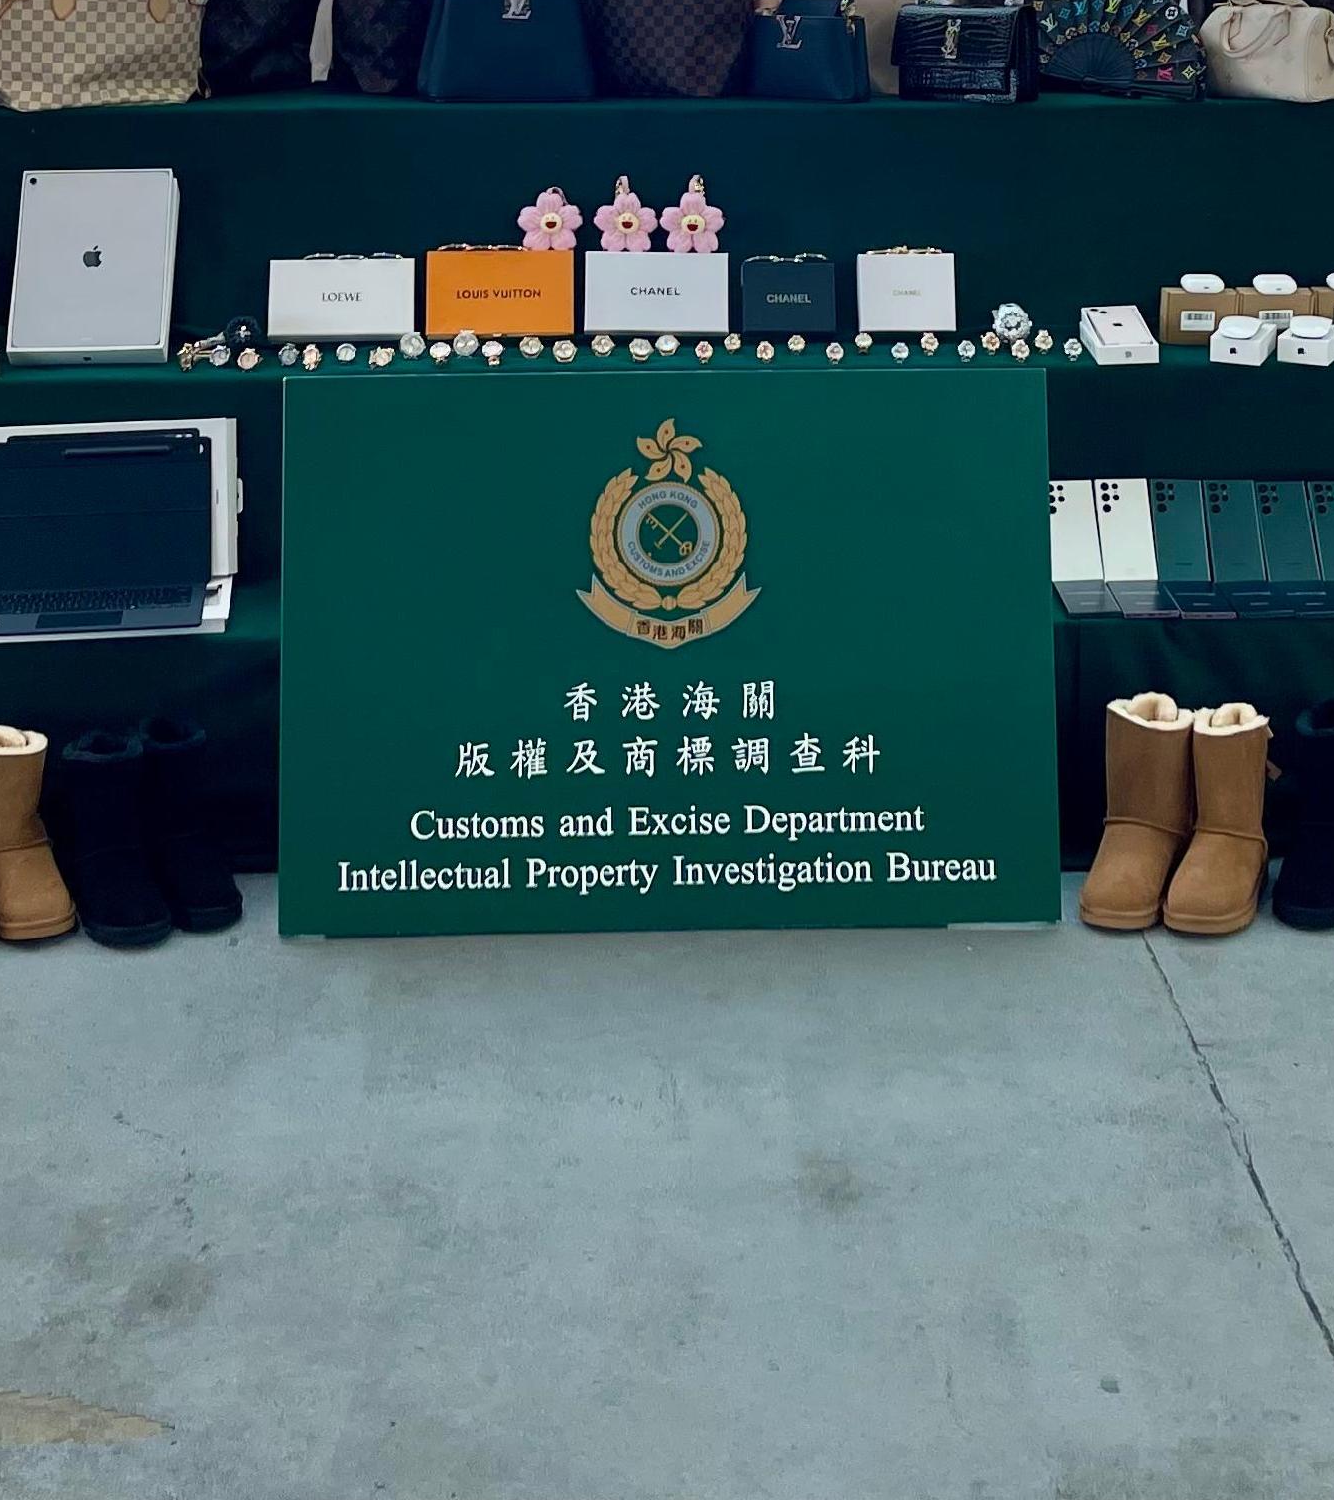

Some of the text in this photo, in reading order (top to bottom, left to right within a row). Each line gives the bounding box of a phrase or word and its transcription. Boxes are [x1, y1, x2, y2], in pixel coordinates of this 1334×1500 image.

[321, 291, 363, 303] LOEWE
[456, 287, 542, 300] LOUIS VUITTON
[629, 286, 682, 297] CHANEL
[766, 293, 812, 304] CHANEL
[638, 490, 699, 510] HONG KONG
[627, 541, 711, 578] CUSTOMS AND EXCISE
[563, 680, 776, 722] 香港海關
[454, 731, 882, 780] 版權及商標調查科
[410, 804, 925, 842] Customs and Excise Department
[338, 852, 997, 896] Intellectual Property Investigation Bureau
